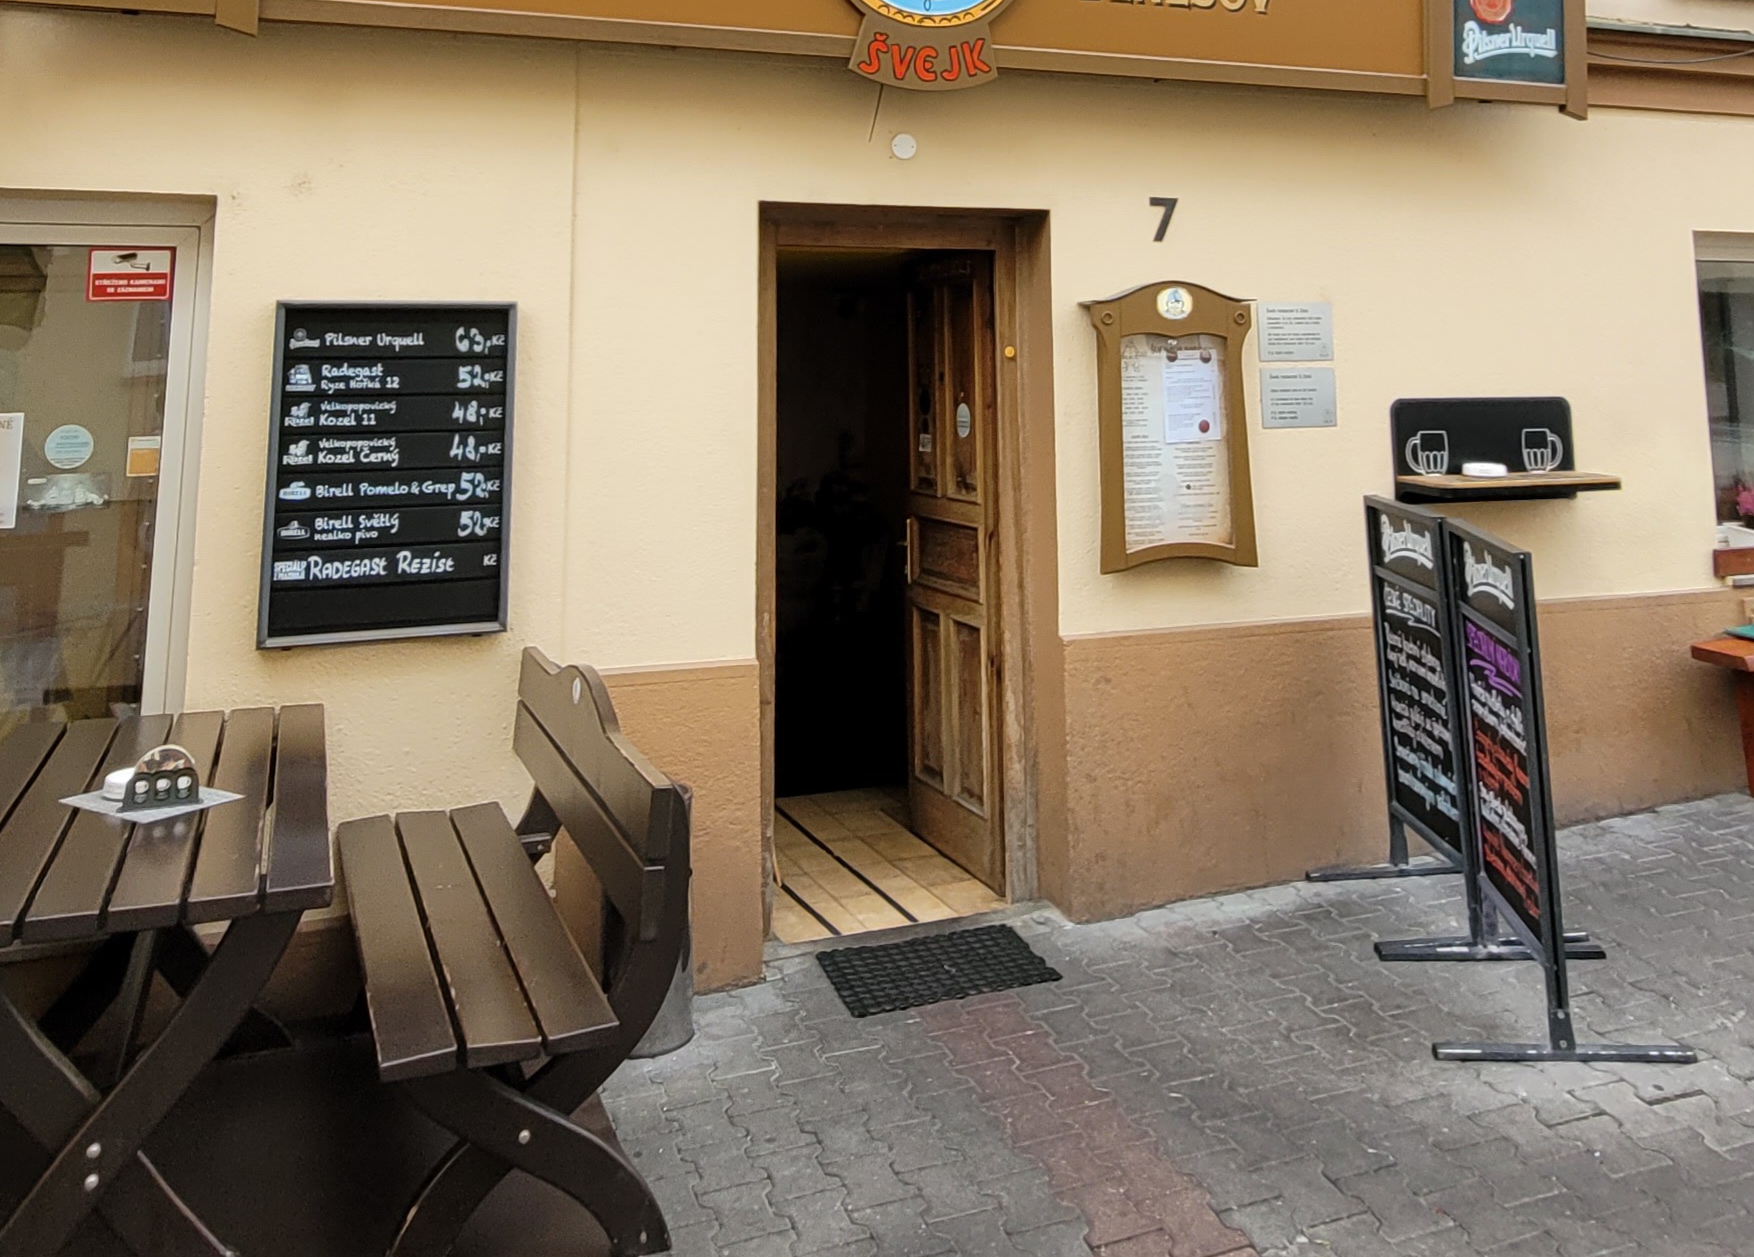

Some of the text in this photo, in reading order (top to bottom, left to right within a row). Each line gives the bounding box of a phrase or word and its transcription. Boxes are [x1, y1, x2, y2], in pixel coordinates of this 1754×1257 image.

[1462, 20, 1556, 64] Pilsner Urquell
[858, 31, 991, 83] ŠVEJK
[1149, 196, 1179, 242] 7
[324, 332, 373, 346] Pilsner
[377, 332, 425, 352] Urquell
[491, 333, 505, 345] Kč
[321, 362, 384, 381] Radegast
[489, 370, 504, 382] Kč
[320, 379, 346, 394] Ryze
[349, 377, 381, 389] Hořká
[385, 376, 400, 388] 12
[320, 401, 397, 414] Velkopopovický
[488, 406, 503, 418] Kč
[319, 413, 377, 426] Kozel 11
[318, 437, 396, 451] Velkopopovický
[487, 442, 502, 454] Kč
[317, 447, 400, 467] Kozel Černý
[315, 480, 456, 500] Birell Pomelo & Grep
[487, 479, 501, 491] Kč
[314, 513, 400, 534] Birell Světlý
[485, 516, 500, 528] Kč
[314, 529, 379, 544] nealko pivo
[482, 554, 498, 566] Kč
